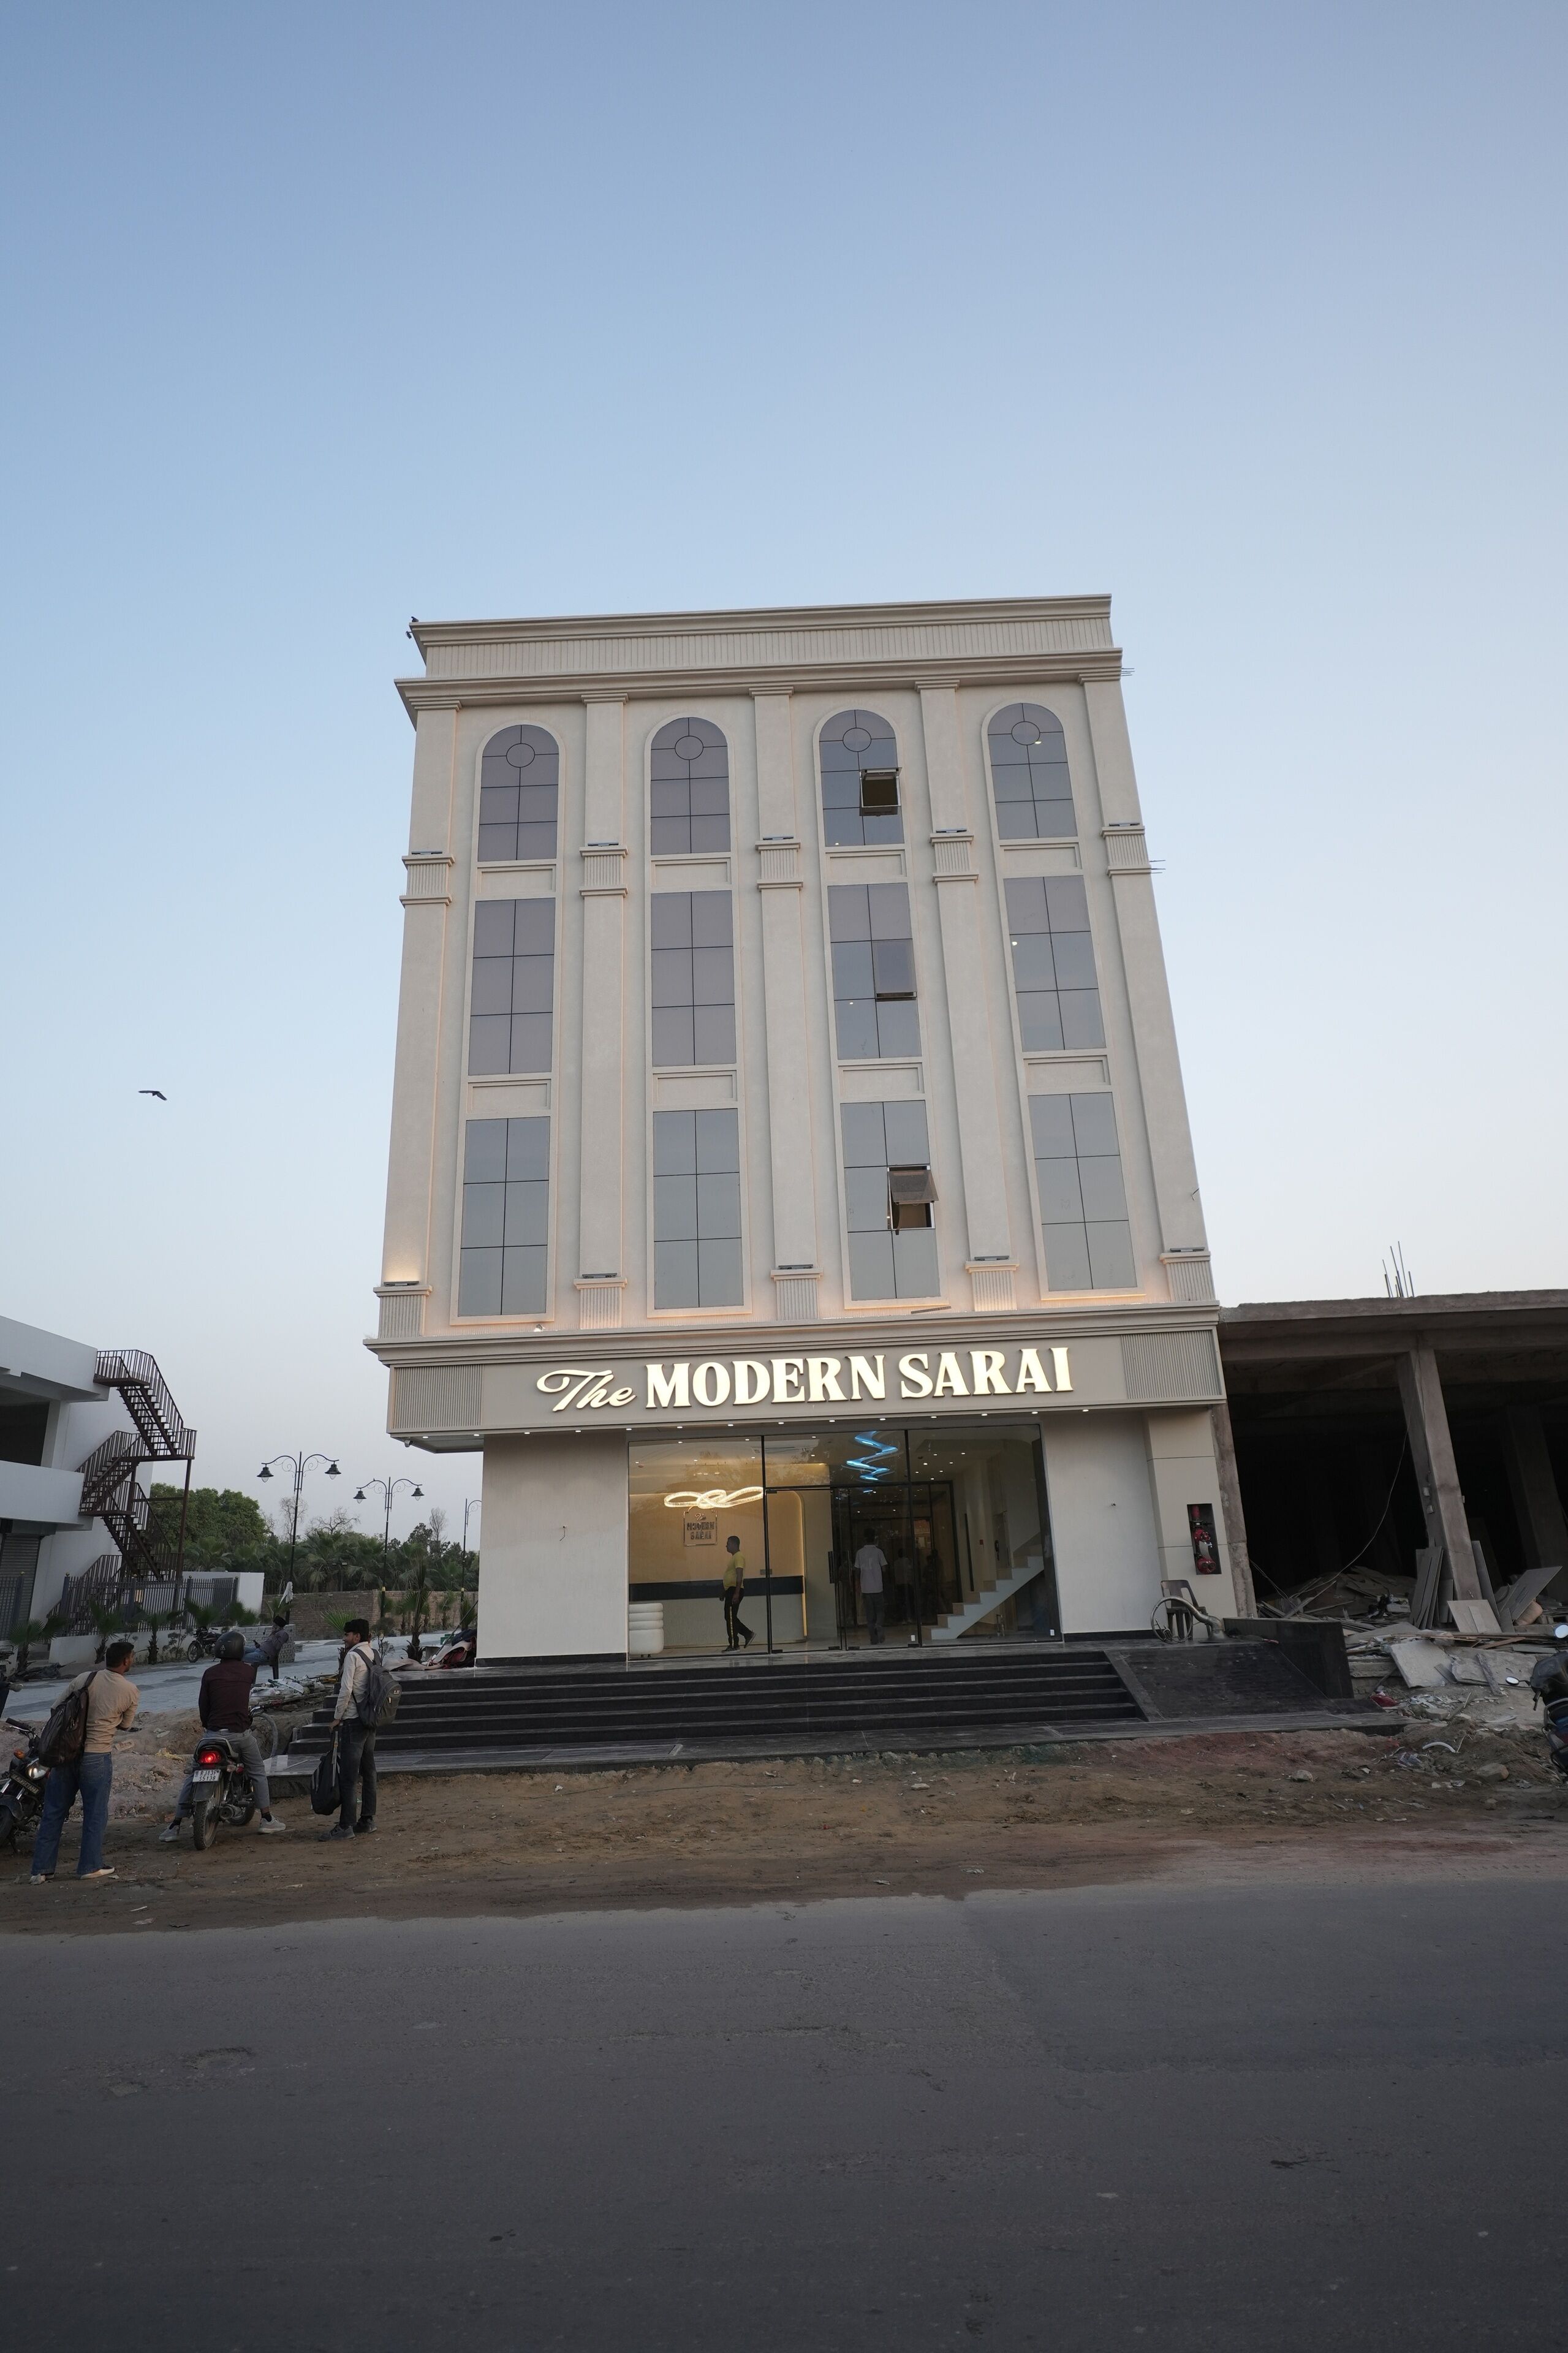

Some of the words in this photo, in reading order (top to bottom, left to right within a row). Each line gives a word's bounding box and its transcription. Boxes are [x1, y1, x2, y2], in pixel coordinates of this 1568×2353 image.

[536, 1369, 637, 1412] The
[645, 1354, 886, 1409] MODERN
[898, 1347, 1074, 1400] SARAI
[687, 1521, 714, 1531] MODERN
[691, 1531, 711, 1540] SARAI
